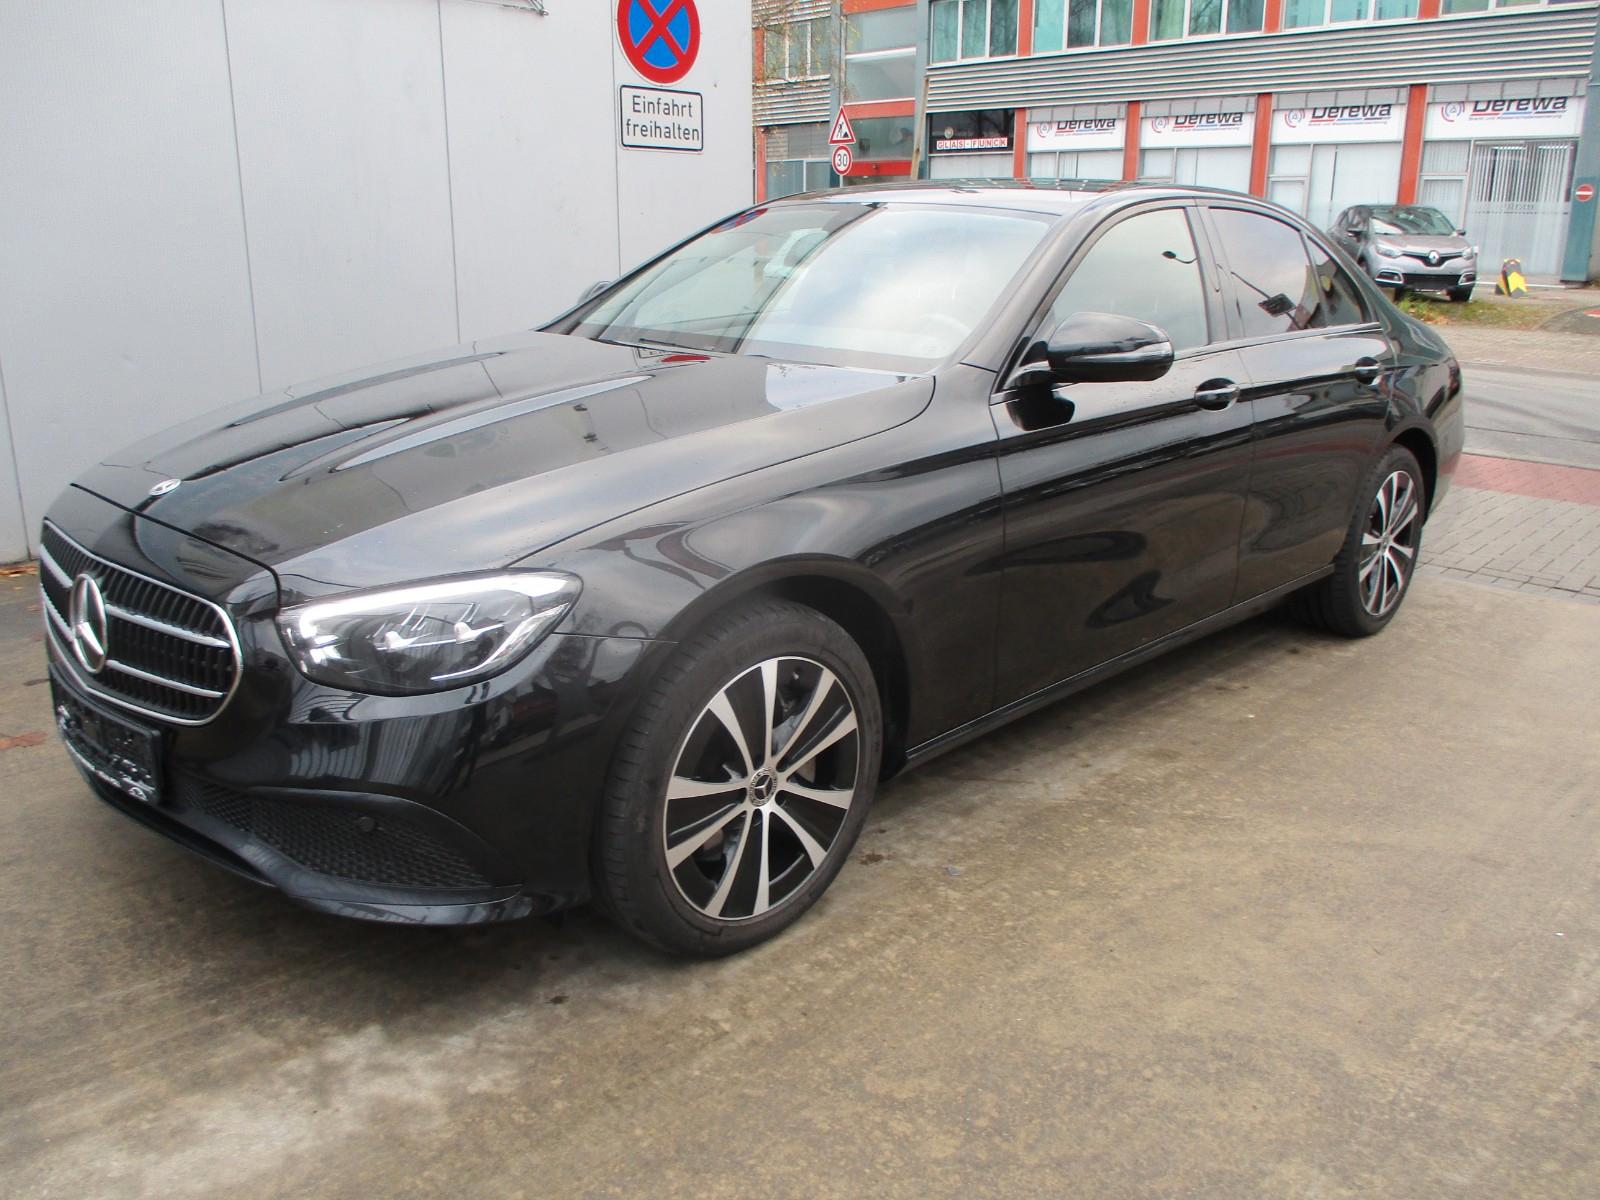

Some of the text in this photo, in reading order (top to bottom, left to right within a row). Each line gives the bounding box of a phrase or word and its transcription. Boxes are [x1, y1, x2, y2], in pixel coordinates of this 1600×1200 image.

[632, 95, 693, 117] Einfahrt
[1311, 103, 1392, 119] Derewa
[1472, 96, 1568, 112] Derewa
[626, 118, 699, 141] freihalten
[836, 155, 848, 167] 30
